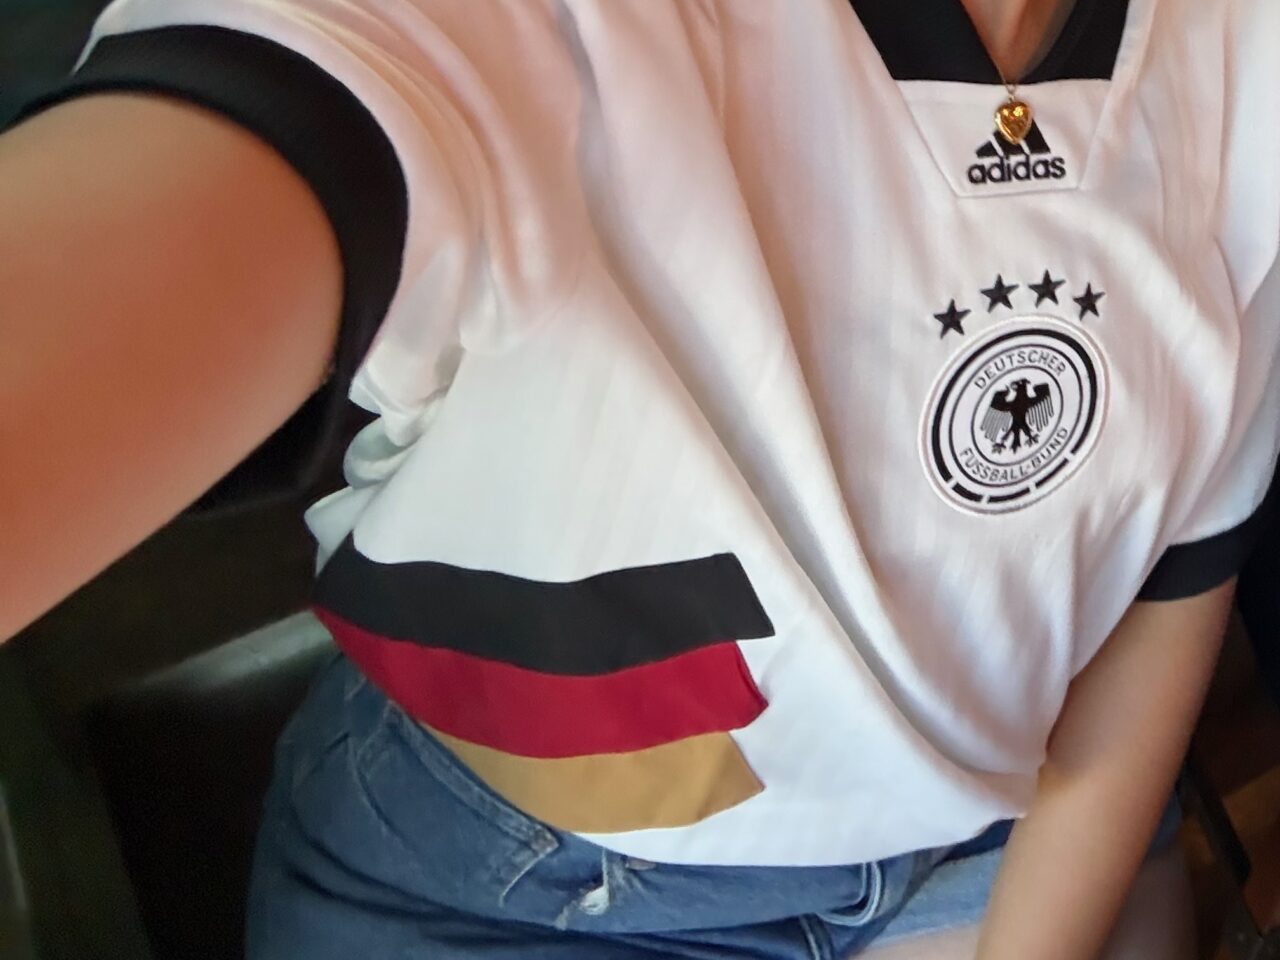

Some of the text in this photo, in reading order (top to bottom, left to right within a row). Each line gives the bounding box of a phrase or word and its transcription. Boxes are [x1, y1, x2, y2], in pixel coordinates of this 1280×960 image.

[967, 153, 1067, 185] adidas
[974, 349, 1067, 390] DEUTSCHER
[959, 427, 1068, 483] FUSSBALL-BUND
